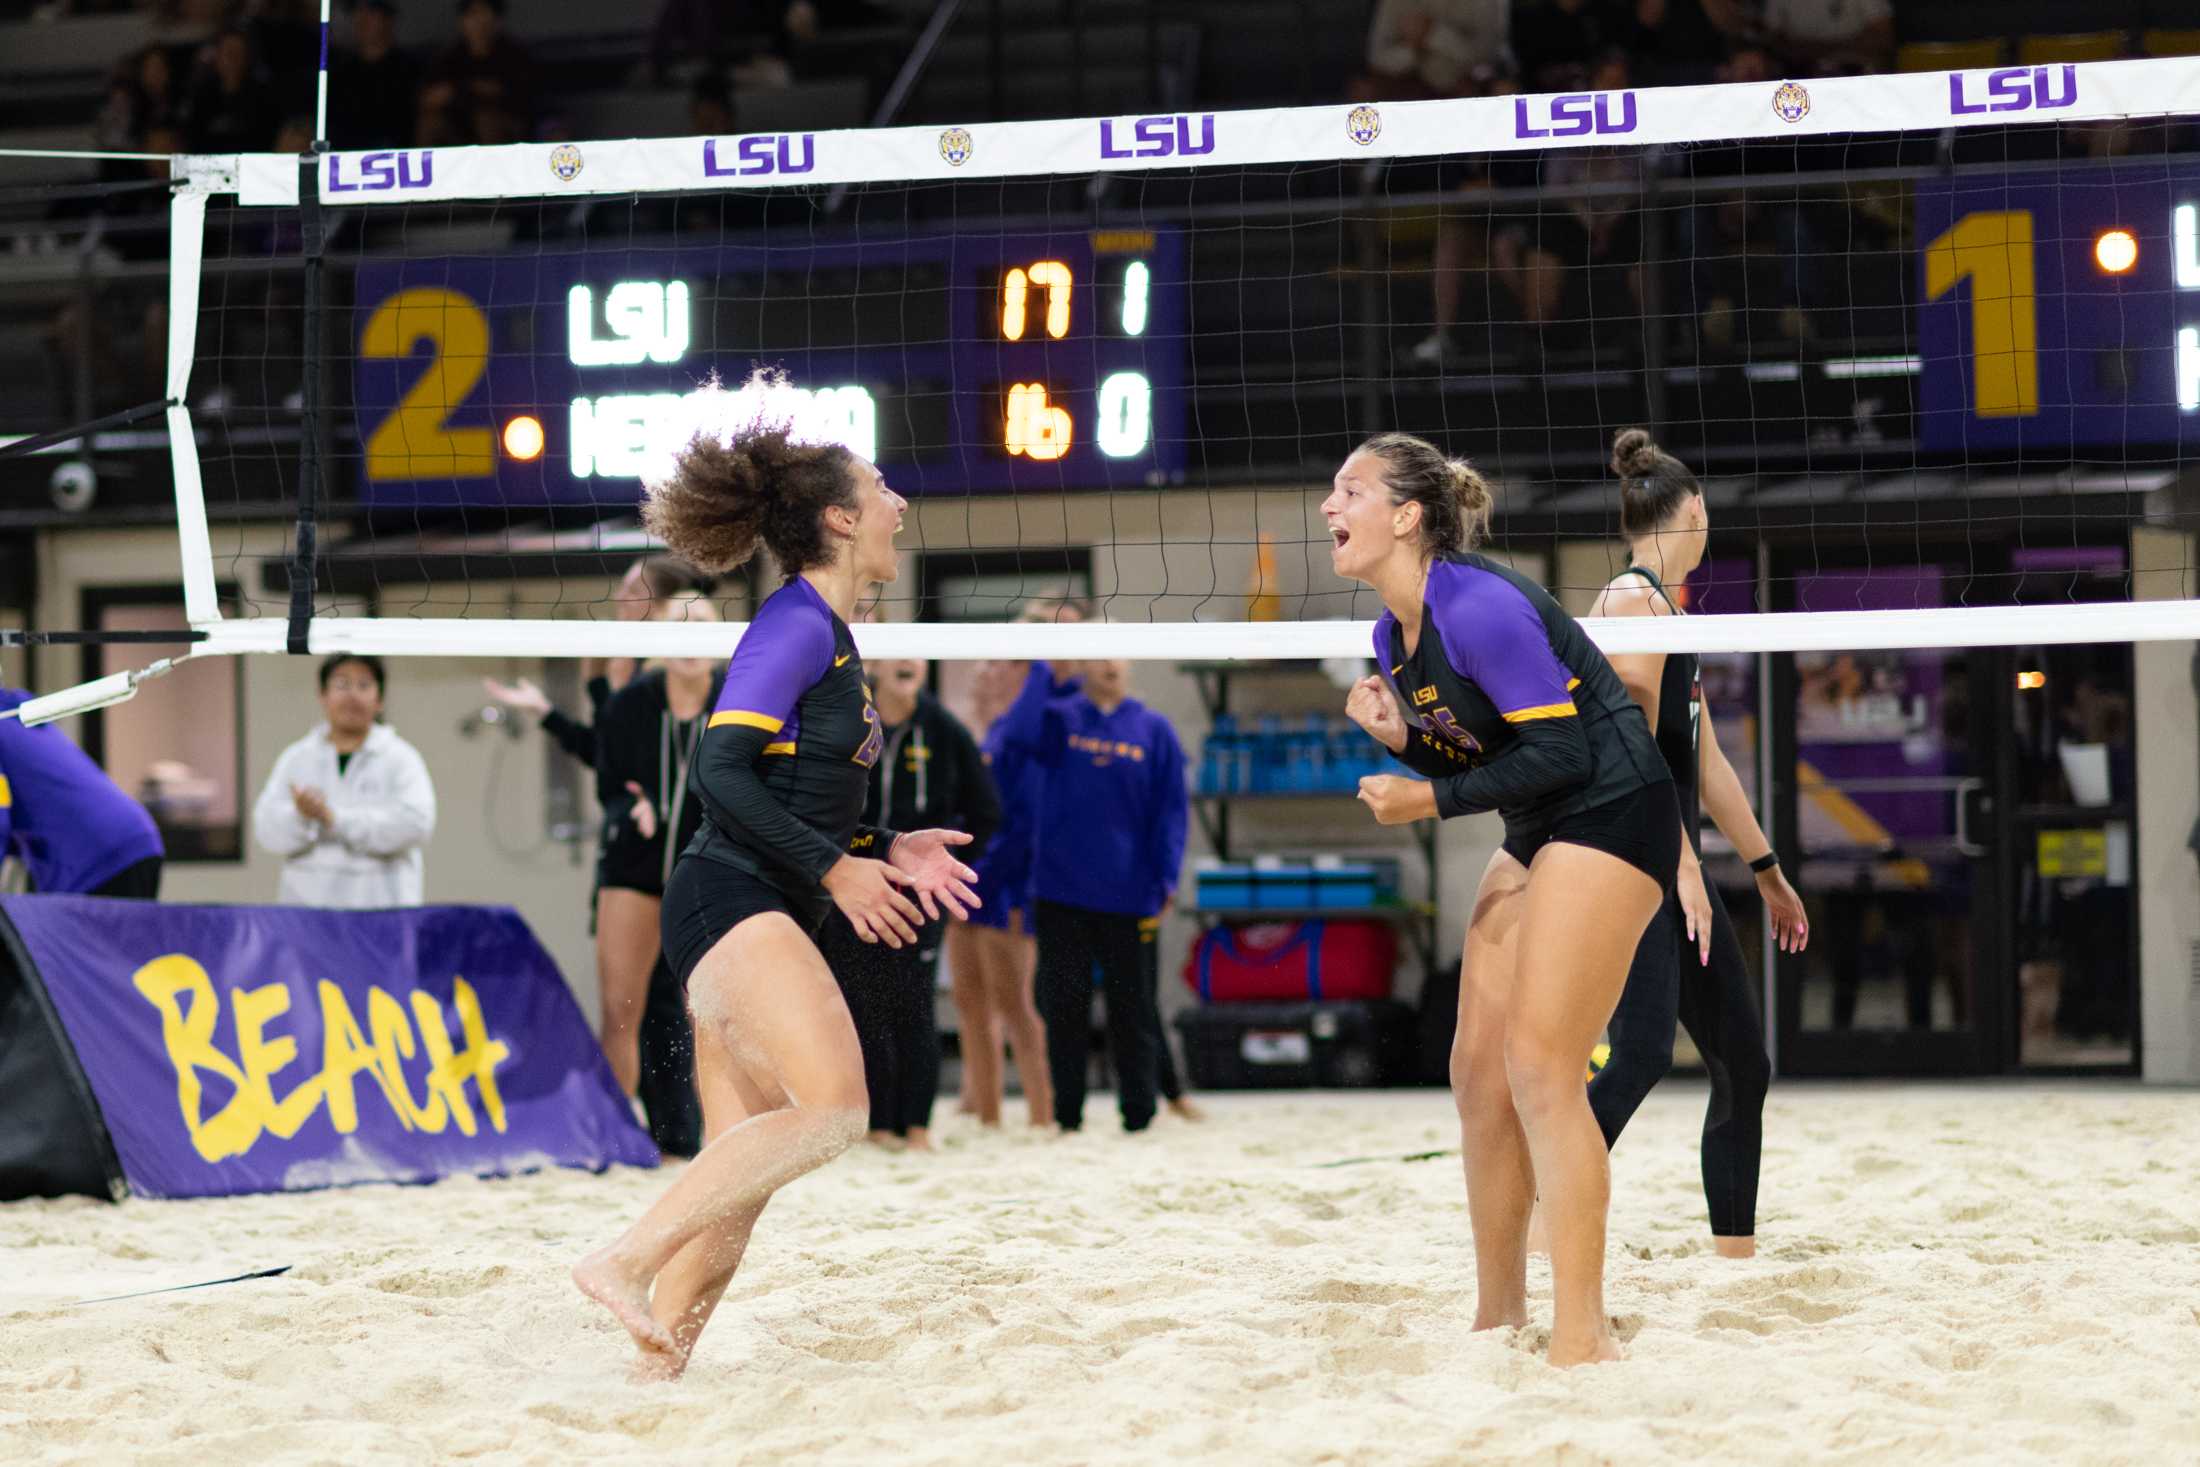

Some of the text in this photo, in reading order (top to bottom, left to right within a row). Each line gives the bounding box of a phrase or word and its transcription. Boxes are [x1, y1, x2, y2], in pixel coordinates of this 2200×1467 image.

[1950, 66, 2077, 114] LSU
[1101, 116, 1214, 158] LSU
[1516, 92, 1636, 138] LSU
[330, 154, 432, 191] LSU
[704, 135, 813, 176] LSU
[569, 261, 1149, 366] LSU 17 1
[1924, 209, 2038, 418] 1
[361, 286, 492, 480] 2
[1006, 372, 1151, 460] 16 0
[1412, 685, 1438, 706] LSU
[132, 952, 511, 1164] BEACH
